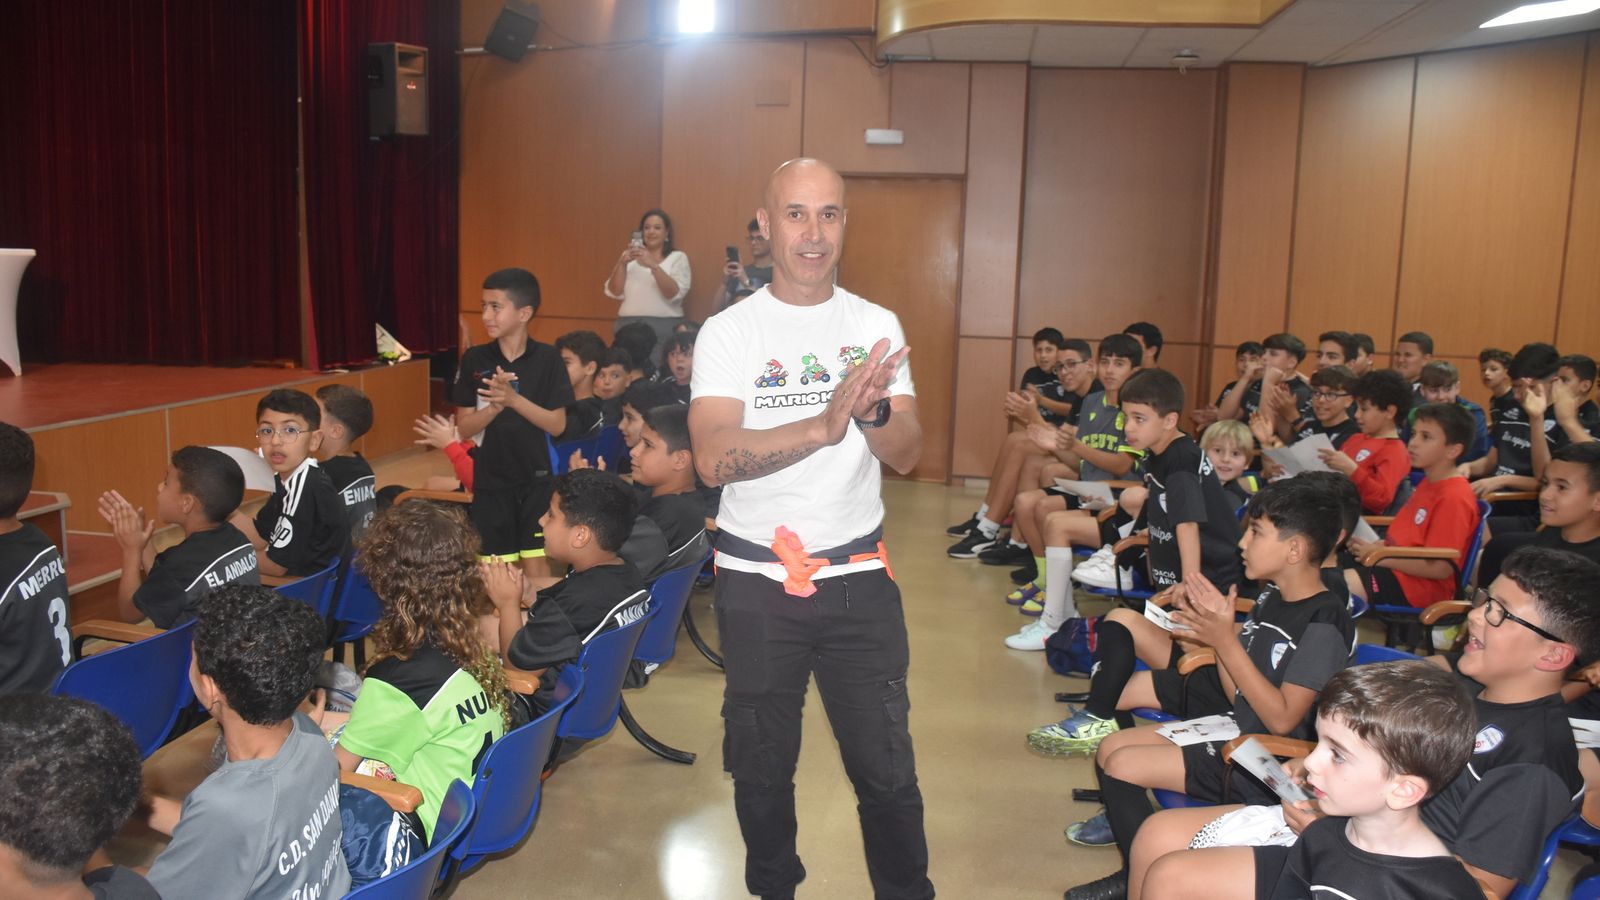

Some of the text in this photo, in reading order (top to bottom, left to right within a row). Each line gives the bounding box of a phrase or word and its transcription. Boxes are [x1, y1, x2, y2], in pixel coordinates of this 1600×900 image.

[1081, 433, 1118, 451] CEUT
[204, 571, 225, 588] EL
[48, 597, 71, 667] 3
[456, 691, 492, 725] NU
[278, 778, 340, 876] C.D. SAN DANI
